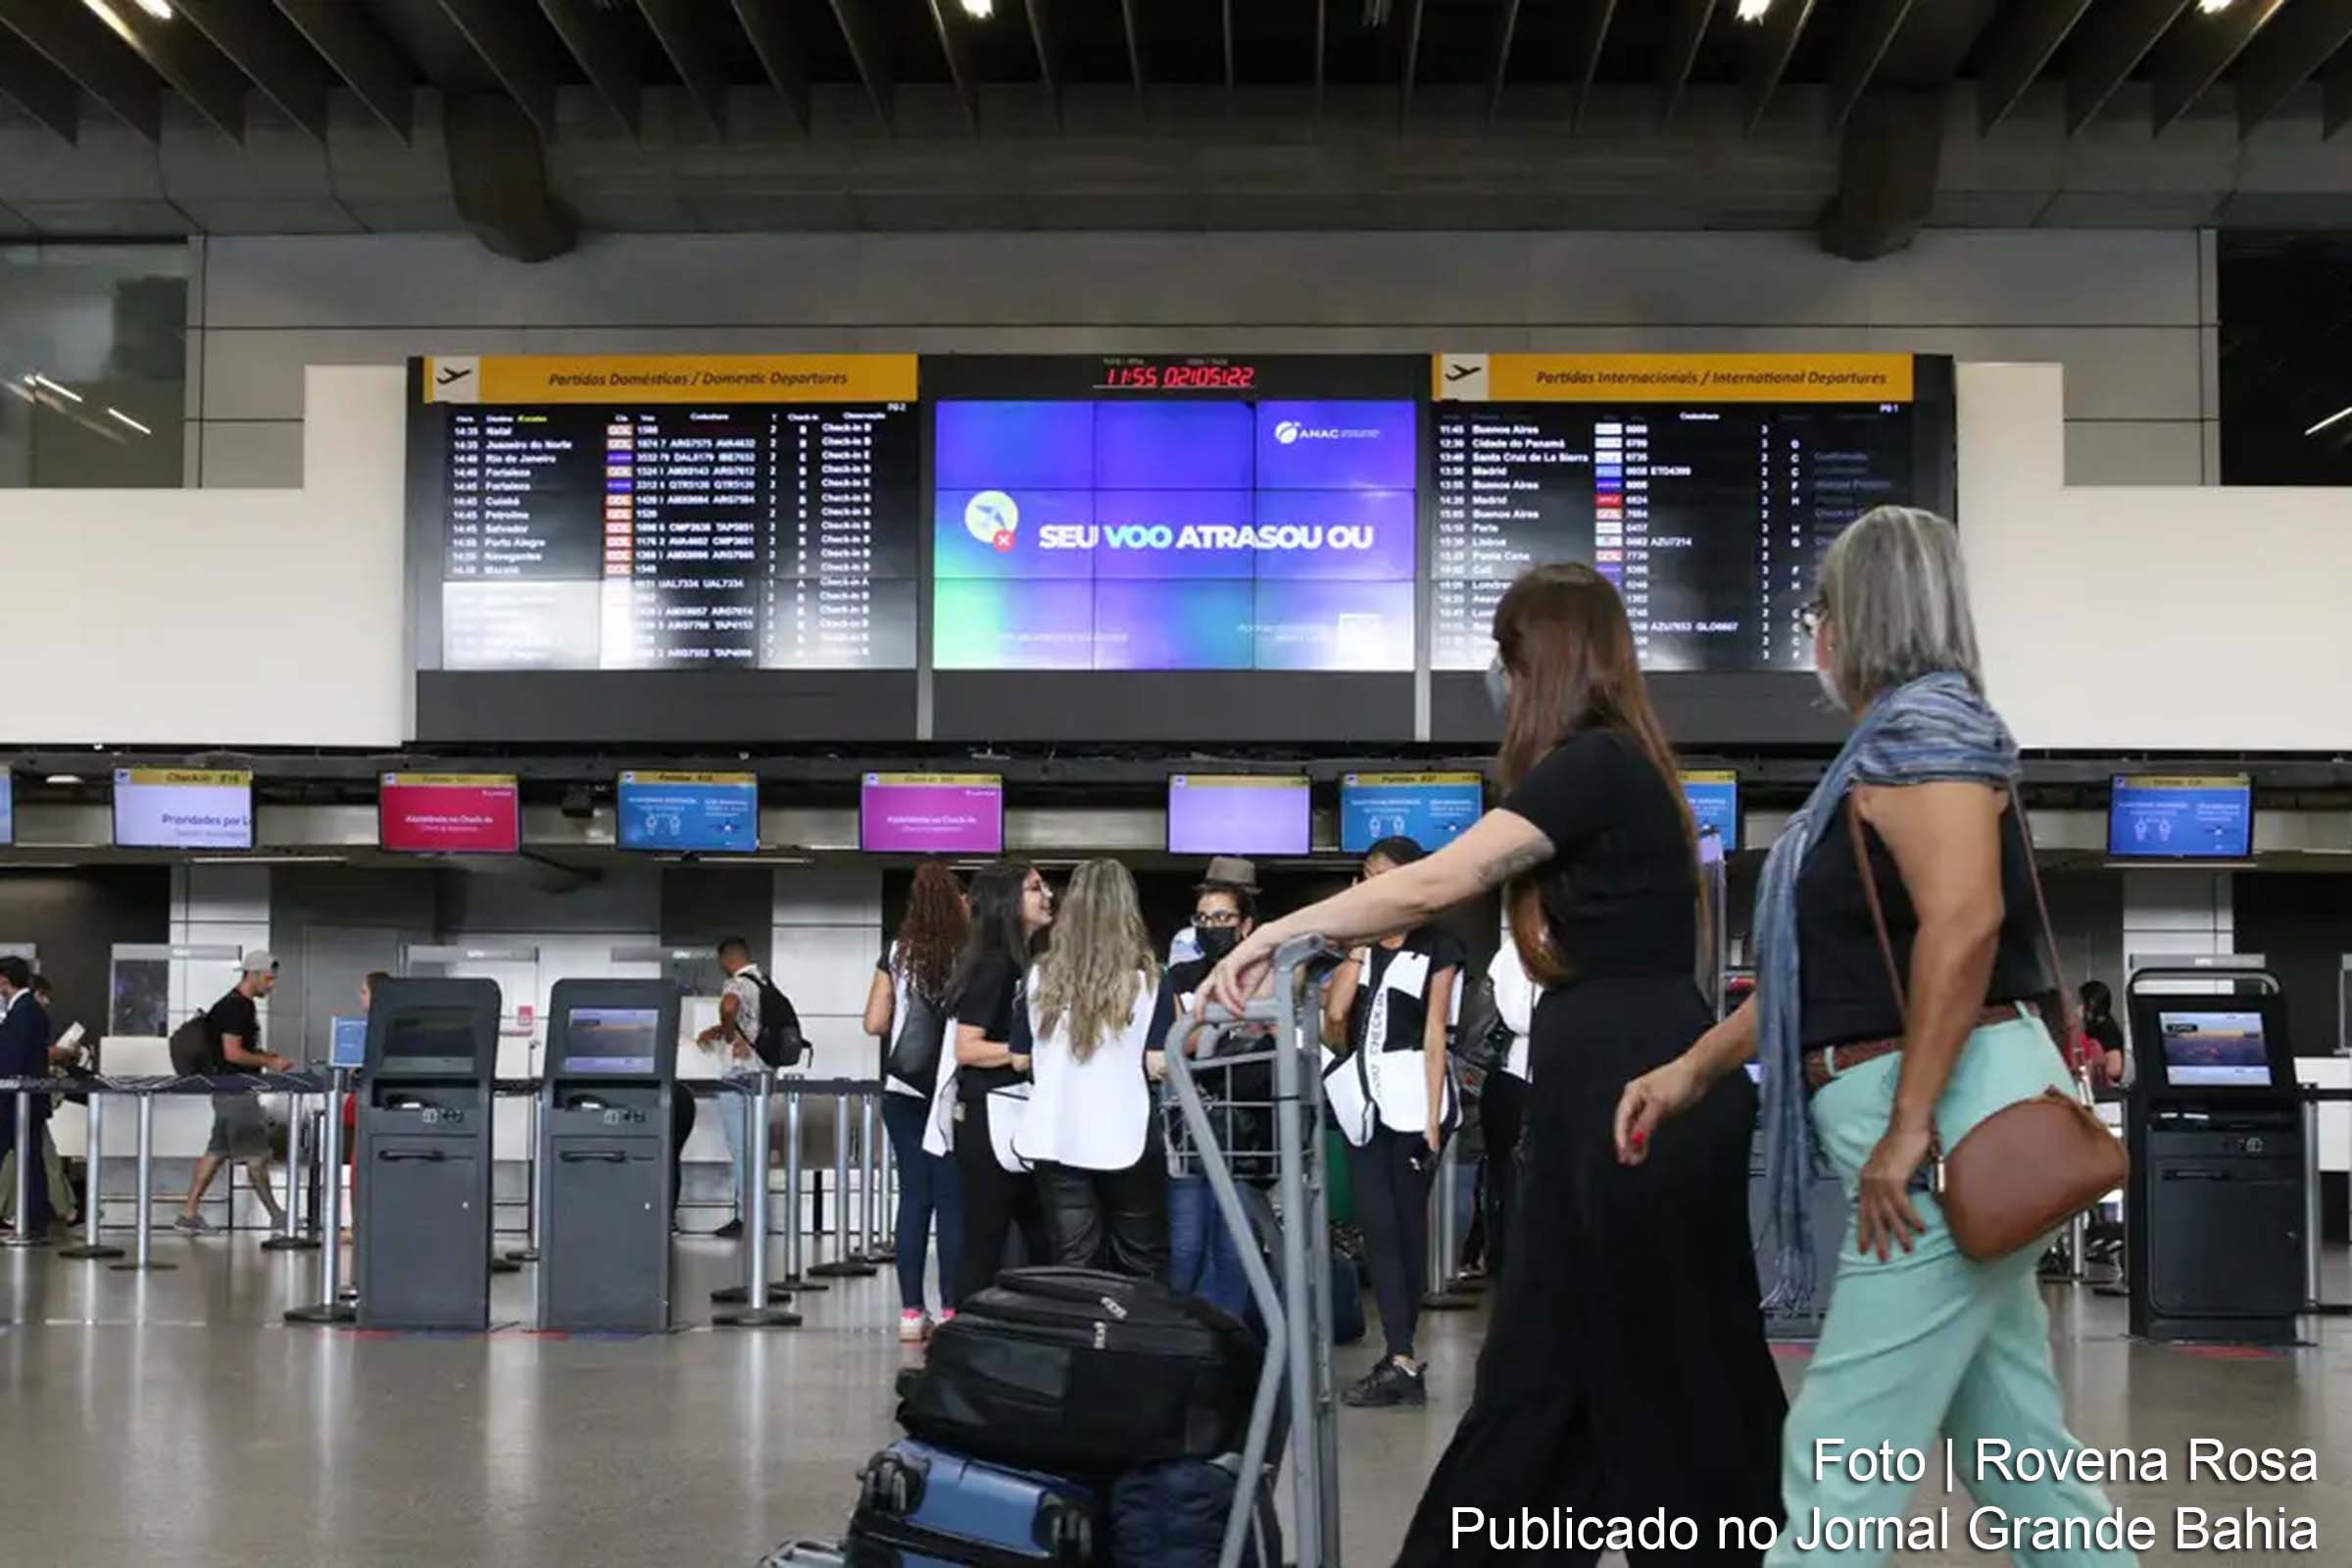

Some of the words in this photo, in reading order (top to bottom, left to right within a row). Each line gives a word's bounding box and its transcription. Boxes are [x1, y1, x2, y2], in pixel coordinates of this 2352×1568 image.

[549, 372, 606, 385] Partidas
[703, 370, 764, 384] Domestic
[770, 370, 848, 386] Departures
[1536, 370, 1595, 385] Partidas
[1598, 370, 1698, 385] Internacionais
[1713, 370, 1804, 385] International
[1807, 371, 1887, 387] Departures
[821, 422, 862, 432] Check-in
[1472, 424, 1510, 435] Buenos
[1512, 424, 1540, 435] Aires
[821, 437, 862, 447] Check-in
[1472, 438, 1507, 449] Cidade
[1509, 438, 1523, 449] do
[1525, 437, 1566, 449] Panamá
[821, 451, 862, 461] Check-in
[1472, 453, 1500, 463] Santa
[1503, 453, 1526, 463] Cruz
[1529, 453, 1542, 463] de
[1543, 453, 1556, 463] La
[1559, 453, 1589, 463] Sierra
[821, 465, 862, 474] Check-in
[1472, 466, 1507, 476] Madrid
[821, 478, 862, 488] Check-in
[1472, 480, 1510, 490] Buenos
[1512, 480, 1540, 490] Aires
[821, 493, 862, 503] Check-in
[1472, 495, 1507, 505] Madrid
[821, 507, 862, 516] Check-in
[1472, 509, 1510, 519] Buenos
[1512, 509, 1540, 519] Aires
[821, 521, 862, 531] Check-in
[821, 535, 862, 545] Check-in
[1038, 524, 1098, 551] SEU
[1103, 524, 1173, 550] VOO
[1175, 524, 1322, 551] ATRASOU
[1326, 524, 1374, 551] OU
[821, 549, 862, 559] Check-in
[162, 812, 221, 825] Prioridades
[223, 816, 240, 828] por
